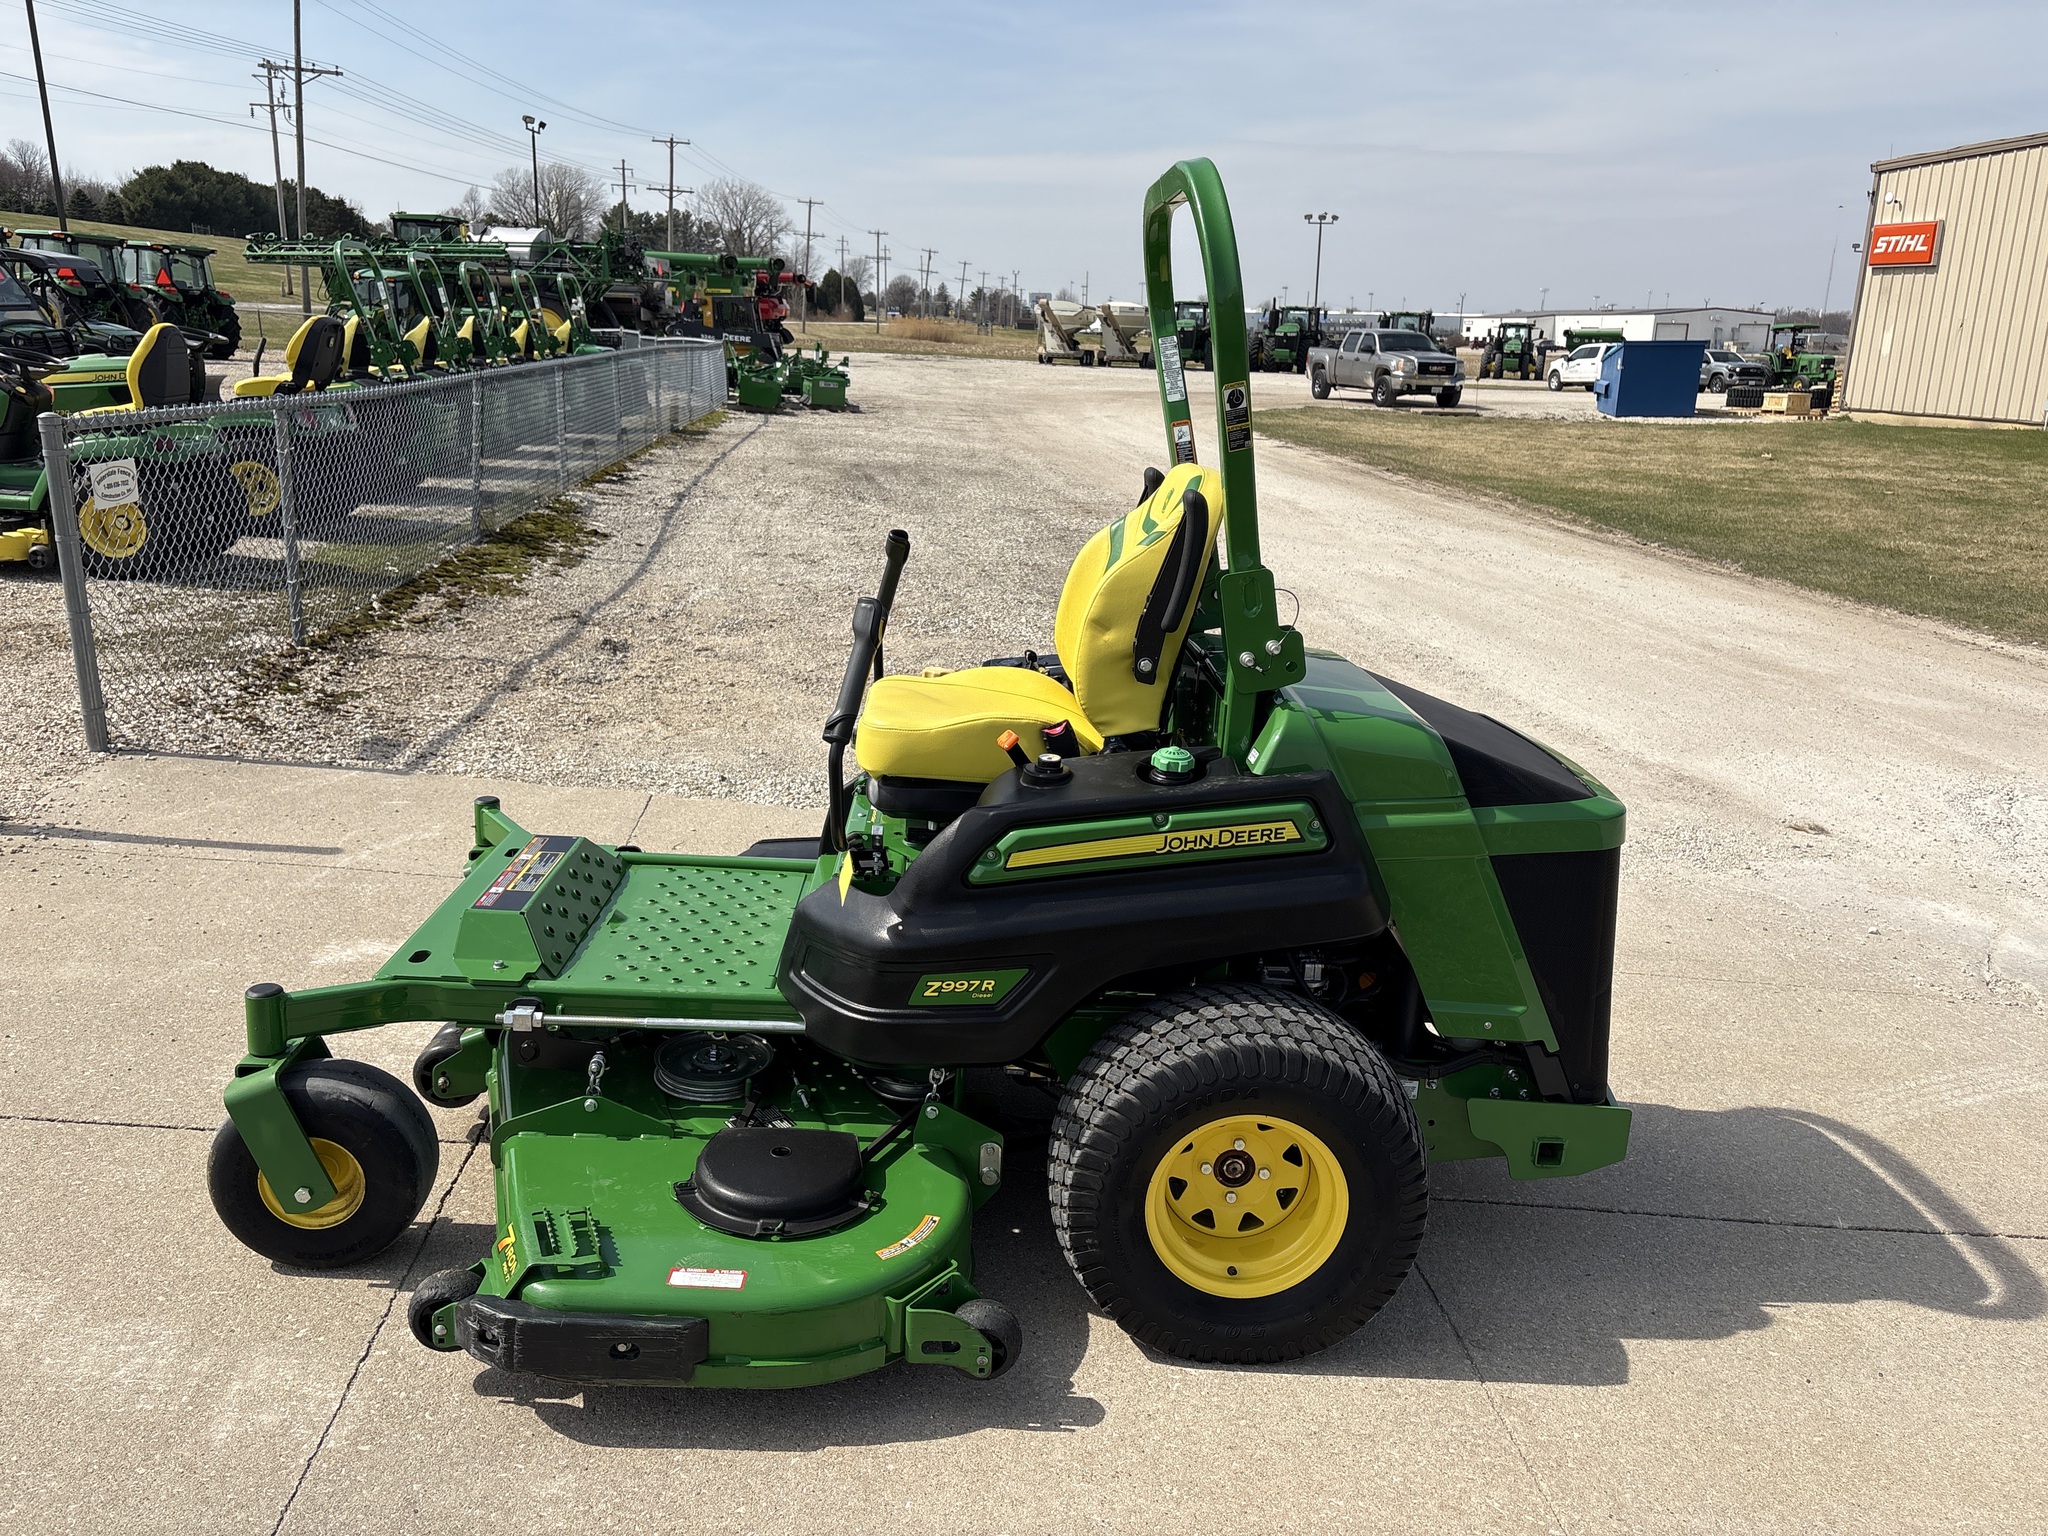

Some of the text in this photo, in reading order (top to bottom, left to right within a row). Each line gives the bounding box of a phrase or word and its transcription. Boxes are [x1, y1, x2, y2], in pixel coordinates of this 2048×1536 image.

[1873, 235, 1928, 254] STIHL
[722, 332, 752, 343] DEERE
[92, 373, 117, 382] JOHN
[117, 468, 131, 477] Fence
[1156, 827, 1286, 852] JOHN DEERE
[923, 979, 996, 997] Z997R
[1152, 1086, 1259, 1135] KENDA
